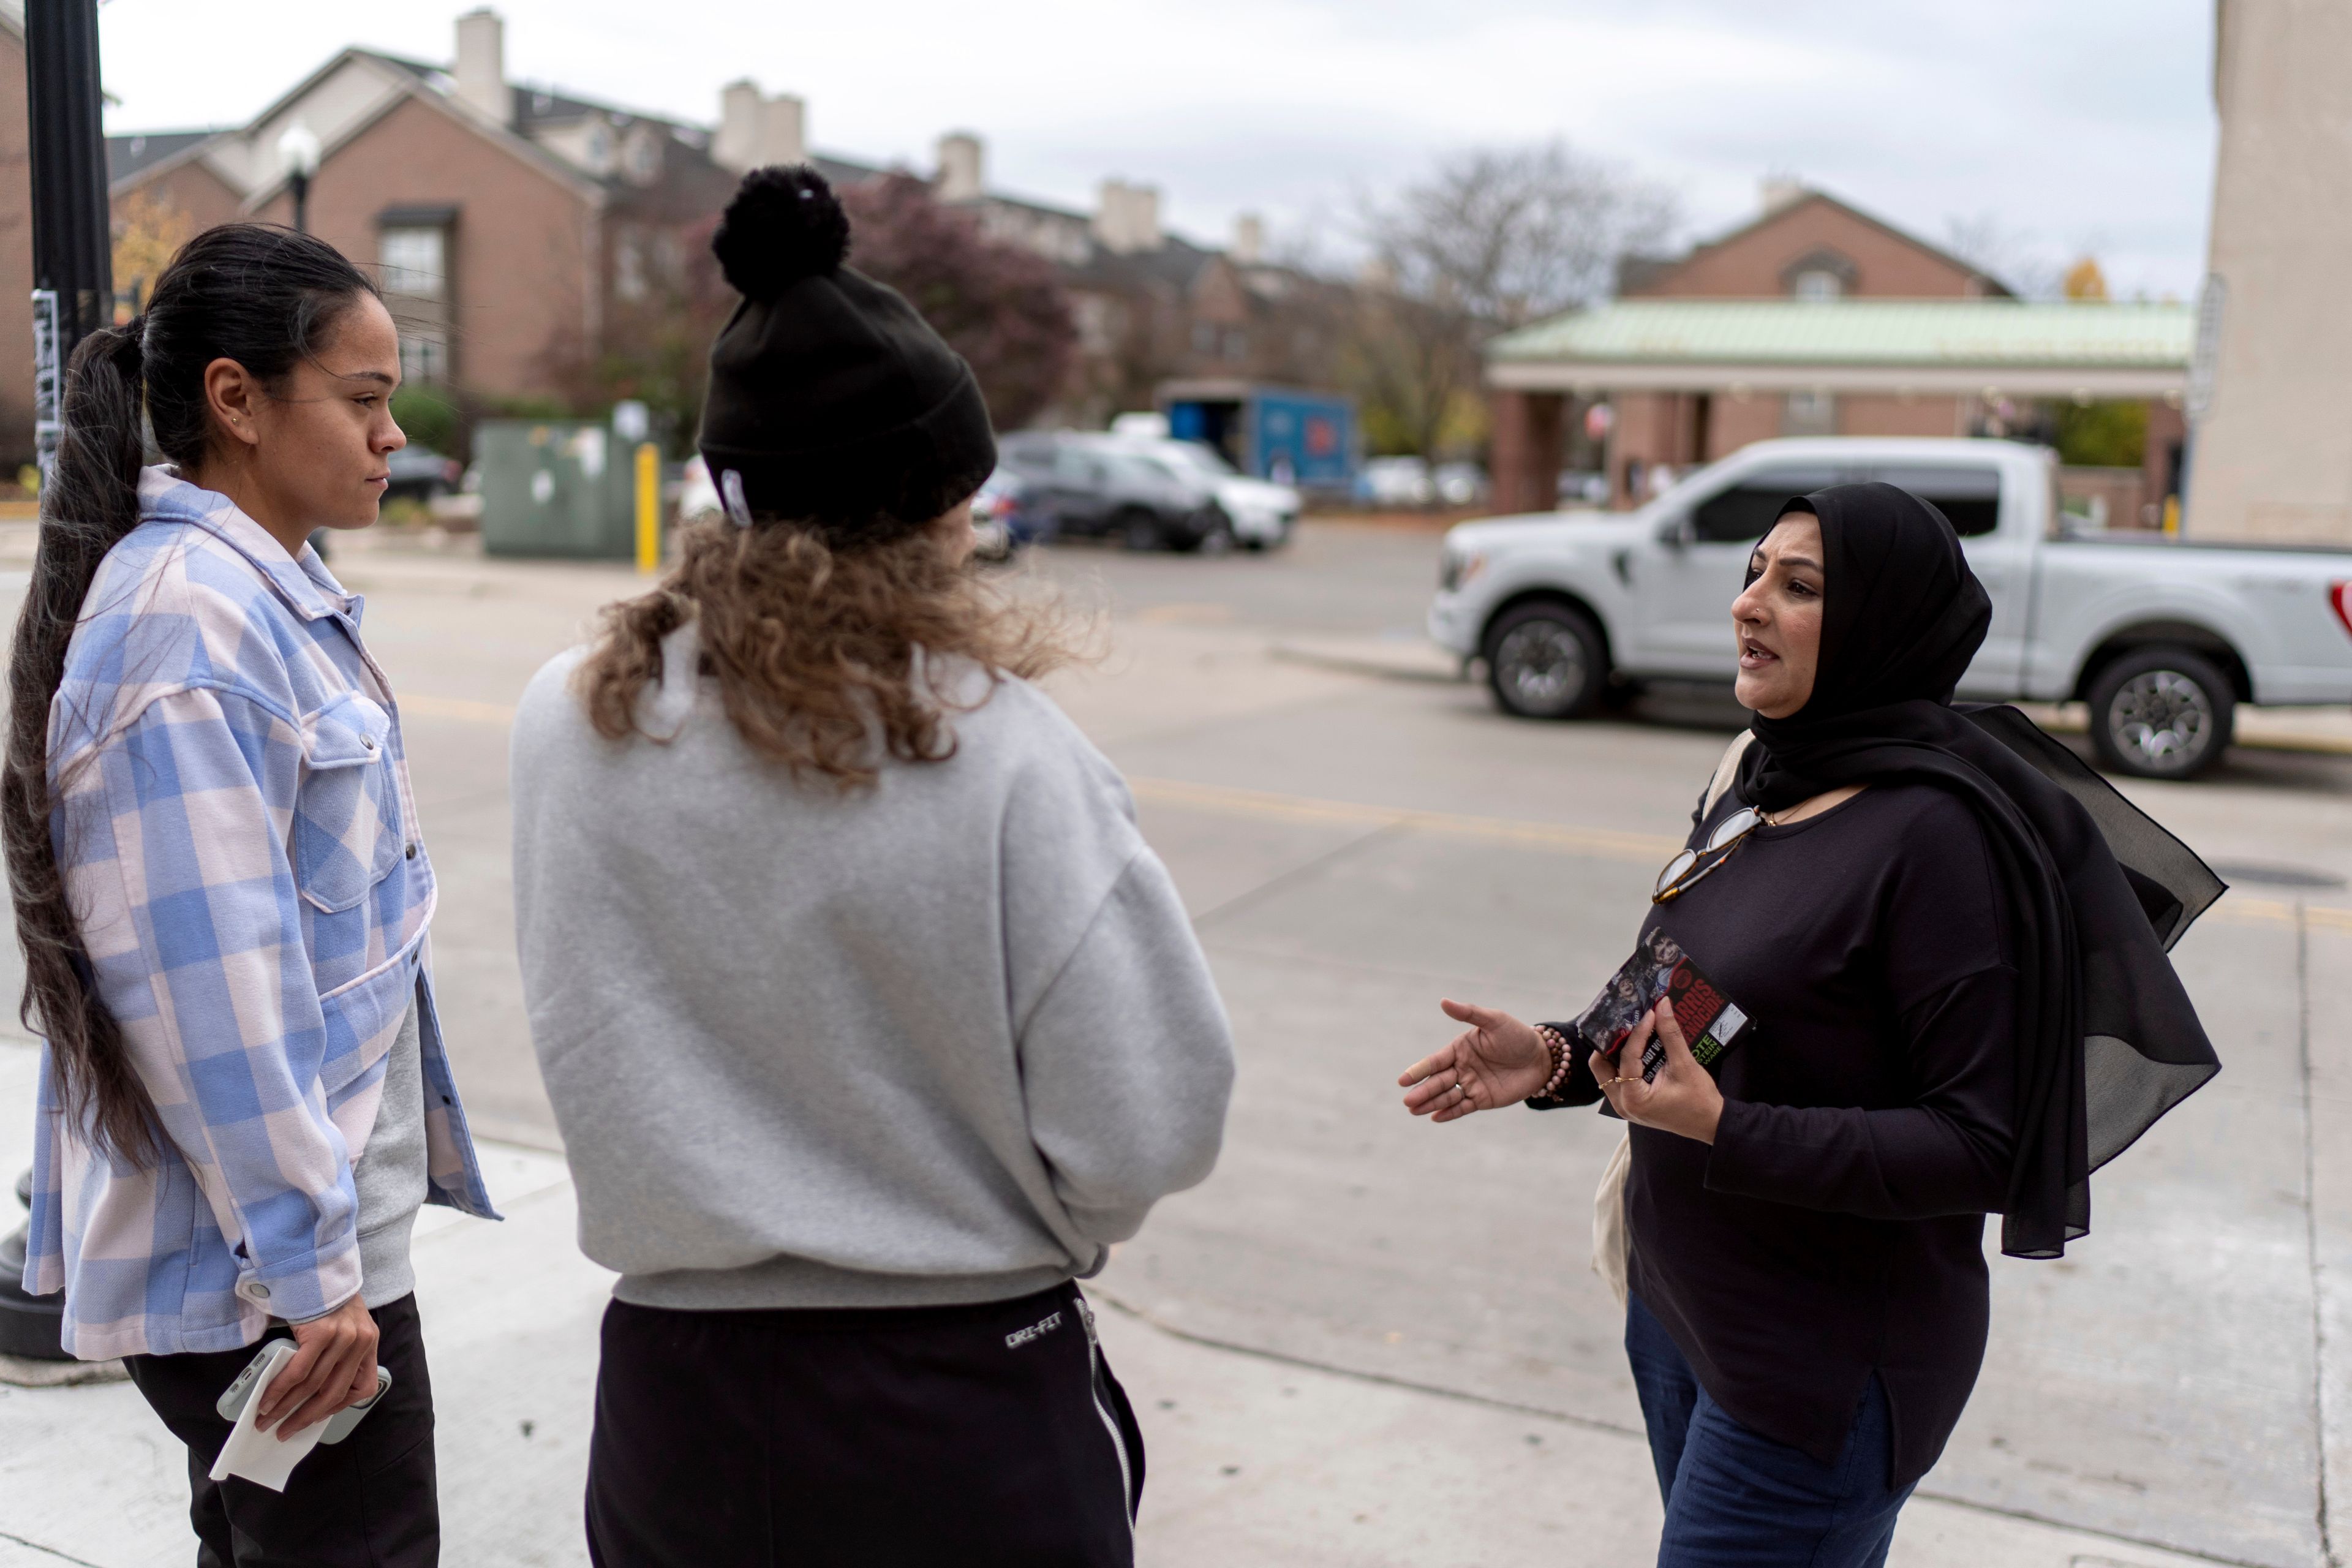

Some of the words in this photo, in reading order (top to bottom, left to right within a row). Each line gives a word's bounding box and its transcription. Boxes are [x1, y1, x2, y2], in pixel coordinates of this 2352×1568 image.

[1673, 979, 1713, 1028] ARRIS
[1681, 991, 1725, 1043] ENOCIDE
[1642, 1048, 1656, 1065] NOT
[1651, 1038, 1664, 1052] VO
[1691, 1034, 1713, 1058] OTE
[1697, 1039, 1717, 1064] STEIN
[1703, 1045, 1722, 1065] WARE
[1644, 1071, 1654, 1082] DO
[1652, 1058, 1666, 1072] NOT
[1005, 1311, 1062, 1349] DRI-FIT
